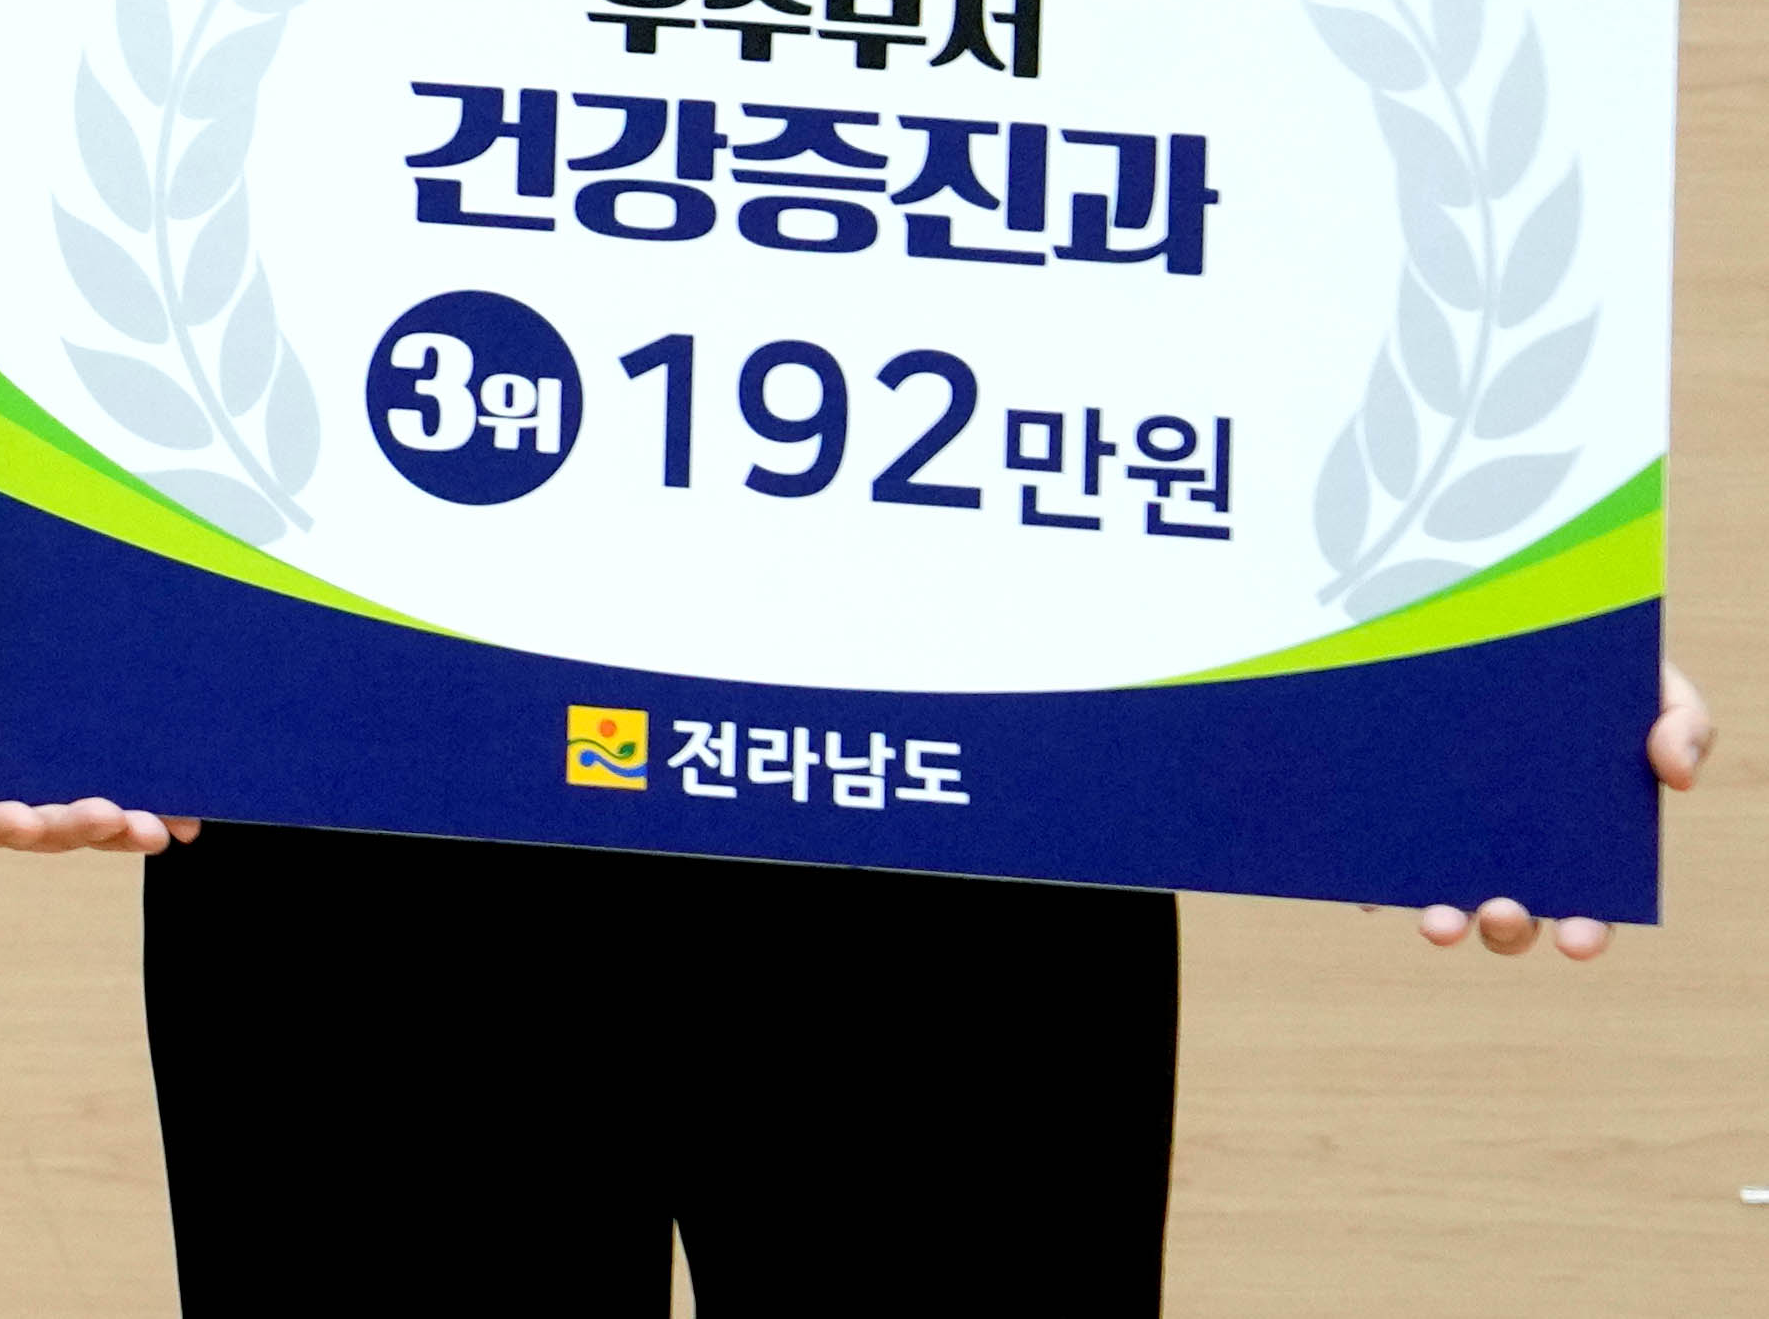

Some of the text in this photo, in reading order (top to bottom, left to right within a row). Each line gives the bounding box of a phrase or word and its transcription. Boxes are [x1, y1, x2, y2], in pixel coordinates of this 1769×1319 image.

[405, 82, 1219, 276] 건강증진과
[389, 333, 561, 452] 3위
[669, 721, 968, 808] 전라남도
